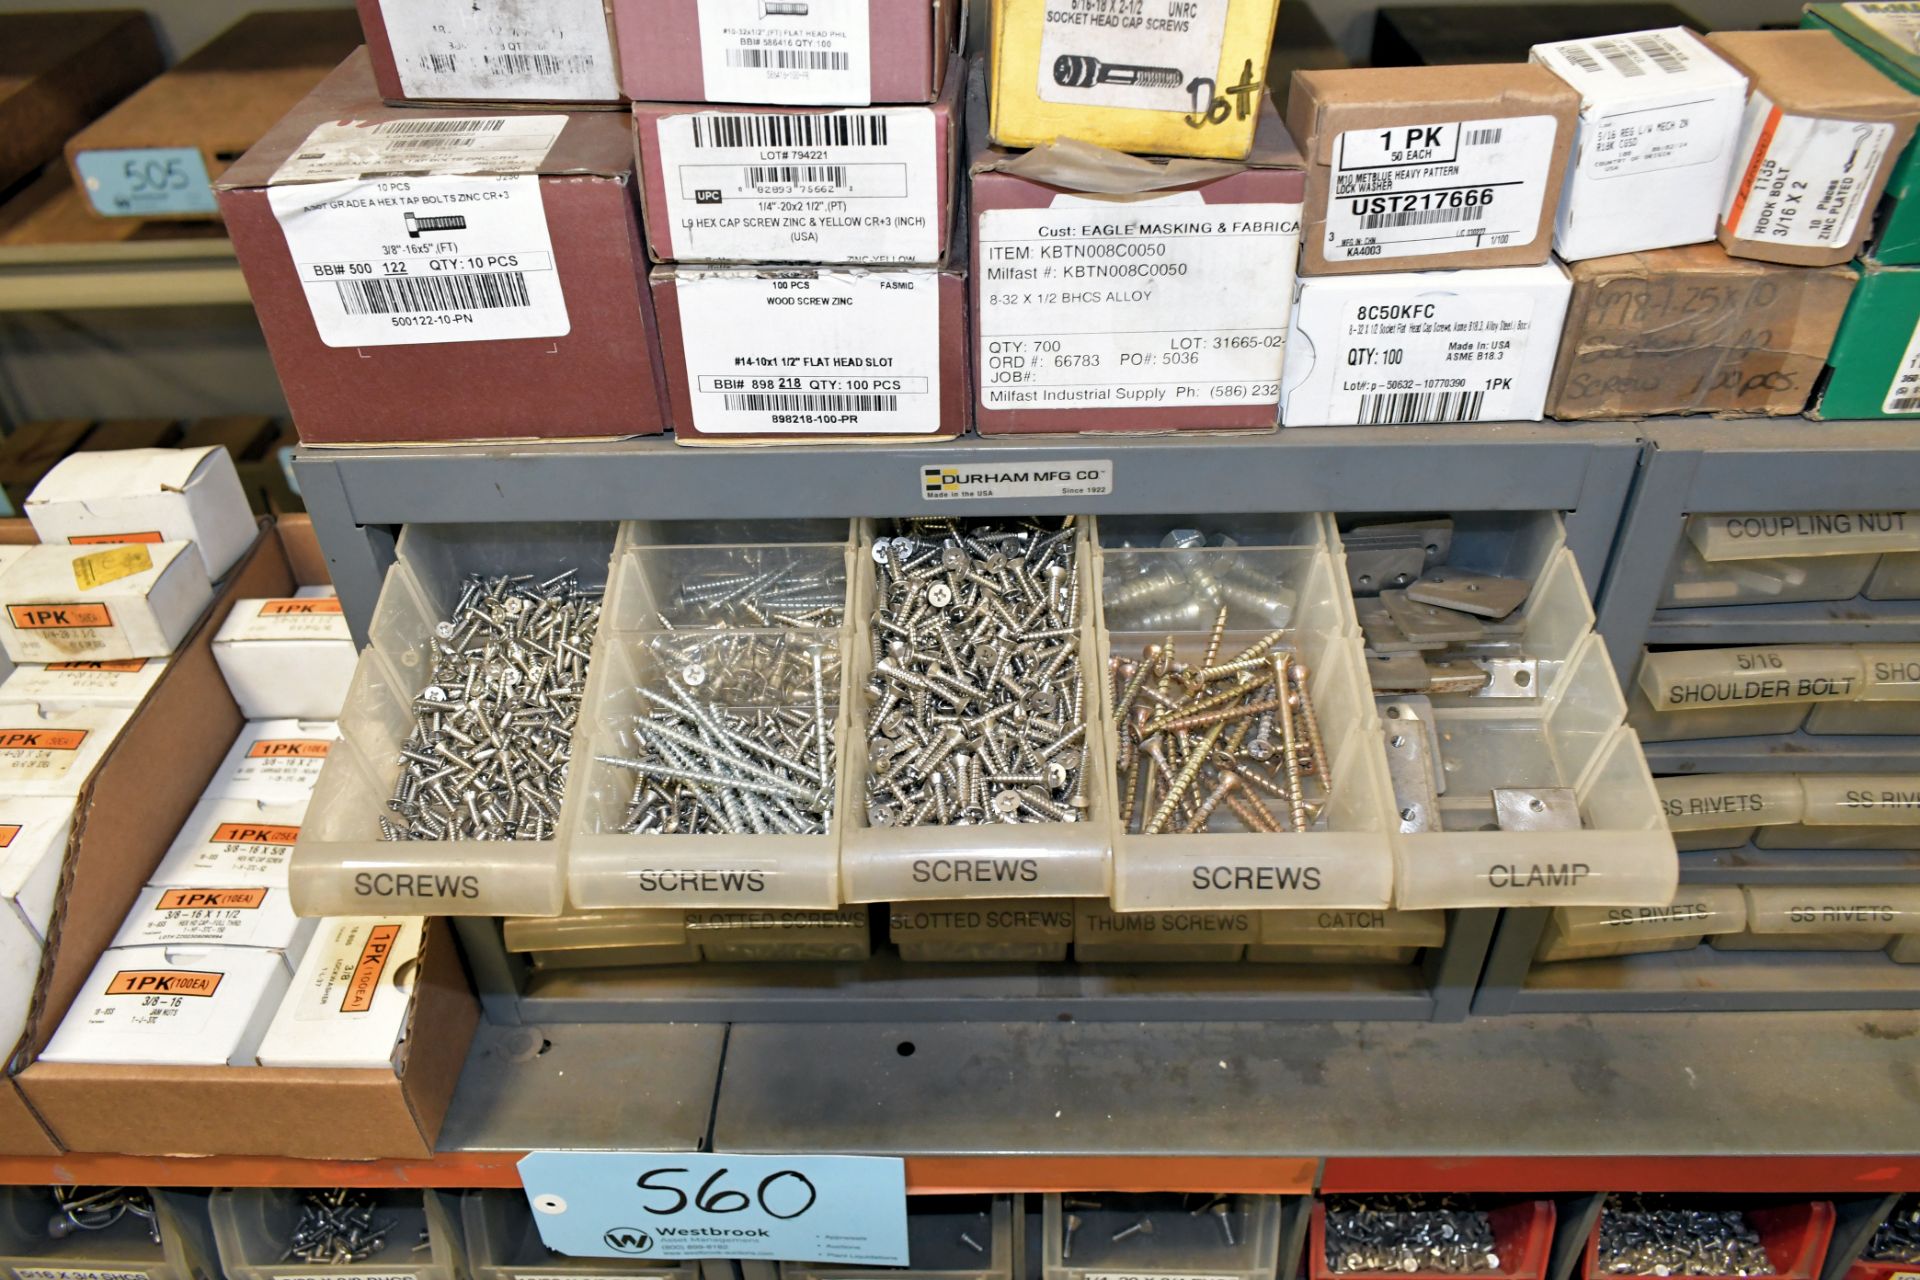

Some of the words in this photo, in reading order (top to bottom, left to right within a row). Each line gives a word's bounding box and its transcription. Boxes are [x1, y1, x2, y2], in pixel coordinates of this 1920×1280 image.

[1168, 2, 1197, 18] UNRC
[1047, 11, 1088, 25] SOCKET
[1090, 14, 1119, 27] HEAD
[1121, 16, 1143, 29] CAP
[1146, 18, 1189, 32] SCREWS
[1406, 127, 1444, 149] PK
[760, 151, 789, 161] LOT#
[791, 151, 828, 161] 794221
[1407, 150, 1432, 160] EACH
[1355, 172, 1392, 184] METBLUE
[1395, 170, 1421, 180] HEAVY
[1423, 166, 1459, 178] PATTERN
[377, 183, 388, 193] 10
[390, 182, 411, 192] PCS
[799, 185, 835, 193] 75662
[1336, 184, 1357, 195] LOCK
[1358, 181, 1393, 192] WASHER
[1791, 181, 1808, 190] 2
[330, 197, 367, 210] GRADE
[378, 197, 398, 208] HEX
[399, 196, 420, 206] TAP
[422, 194, 457, 204] BOLTS
[458, 192, 481, 202] ZINC
[697, 191, 721, 202] UPC
[1352, 189, 1494, 216] UST217666
[1754, 201, 1777, 235] HOOK
[1769, 167, 1791, 197] BOLT
[1785, 194, 1802, 204] X
[1809, 219, 1822, 230] 10
[1816, 179, 1840, 211] Pieces
[1818, 217, 1837, 240] ZINC
[1829, 177, 1855, 215] PLATED
[681, 218, 694, 229] L9
[696, 219, 717, 228] HEX
[719, 218, 741, 228] CAP
[743, 218, 781, 228] SCREW
[782, 218, 807, 227] ZINC
[809, 218, 818, 227] &
[819, 217, 863, 227] YELLOW
[864, 217, 892, 227] CR+3
[893, 216, 926, 228] (INCH)
[1038, 226, 1077, 238] Cust:
[1081, 224, 1134, 237] EAGLE
[1139, 222, 1213, 235] MASKING
[1217, 222, 1227, 234] &
[1232, 221, 1301, 234] FABRICA
[1772, 208, 1797, 237] 3/16
[790, 231, 819, 243] (USA)
[1328, 232, 1335, 242] 3
[989, 246, 1035, 261] ITEM:
[1040, 243, 1166, 259] KBTN008C0050
[1347, 246, 1382, 257] KA4003
[313, 264, 345, 276] BBI#
[349, 263, 373, 275] 500
[383, 261, 408, 276] 122
[429, 259, 465, 272] QTY:
[468, 257, 484, 269] 10
[488, 255, 519, 268] PCS
[987, 267, 1039, 281] Milfast
[1043, 266, 1057, 279] #:
[1063, 263, 1188, 279] KBTN008C0050
[773, 281, 789, 290] 100
[790, 281, 810, 291] PCS
[767, 296, 796, 306] WOOD
[797, 296, 830, 306] SCREW
[832, 296, 853, 306] ZINC
[990, 293, 1019, 306] 8-32
[1023, 293, 1033, 304] X
[1038, 292, 1057, 304] 1/2
[1061, 291, 1102, 304] BHCS
[1106, 291, 1152, 303] ALLOY
[391, 313, 474, 327] 500122-10-PN
[1356, 304, 1436, 321] 8C50KFC
[989, 341, 1027, 354] QTY:
[1033, 340, 1061, 353] 700
[1170, 336, 1207, 351] LOT:
[1383, 348, 1403, 365] 100
[1448, 341, 1474, 351] Made
[1491, 340, 1511, 350] USA
[735, 357, 778, 368] #14-10x1
[781, 357, 801, 367] 1/2"
[803, 357, 830, 367] FLAT
[833, 357, 863, 367] HEAD
[865, 357, 893, 367] SLOT
[989, 355, 1025, 370] ORD
[1030, 355, 1044, 368] #:
[1054, 354, 1100, 368] 66783
[1120, 352, 1157, 367] PO#:
[1162, 352, 1199, 365] 5036
[1446, 352, 1474, 362] ASME
[1476, 351, 1504, 361] B18.3
[714, 378, 745, 390] BBI#
[751, 378, 775, 390] 898
[778, 377, 802, 390] 218
[809, 379, 842, 391] QTY:
[846, 379, 869, 390] 100
[873, 379, 902, 390] PCS
[1485, 378, 1513, 391] 1PK
[990, 388, 1038, 403] Milfast
[1042, 387, 1111, 401] Industrial
[1115, 386, 1167, 403] Supply
[1210, 384, 1248, 399] (586)
[771, 414, 858, 424] 898218-100-PR
[942, 472, 1029, 485] DURHAM
[1033, 471, 1071, 482] MFG
[1087, 486, 1106, 494] 1922
[1726, 515, 1852, 539] COUPLING
[1857, 511, 1908, 533] NUT
[23, 610, 70, 625] 1PK
[274, 604, 315, 614] 1PK
[1736, 653, 1783, 670] 5/16
[1669, 679, 1791, 704] SHOULDER
[1796, 676, 1856, 697] BOLT
[261, 743, 304, 754] 1PK
[1690, 793, 1764, 815] RIVETS
[1846, 791, 1874, 809] SS
[230, 828, 272, 842] 1PK
[912, 859, 1038, 883] SCREWS
[1193, 866, 1321, 891] SCREWS
[1488, 863, 1590, 889] CLAMP
[354, 872, 480, 899] SCREWS
[639, 868, 765, 892] SCREWS
[176, 894, 222, 906] 1PK
[685, 912, 774, 931] SLOTTED
[781, 912, 866, 929] SCREWS
[891, 912, 981, 930] SLOTTED
[986, 911, 1073, 929] SCREWS
[1087, 914, 1156, 933] THUMB
[1161, 913, 1249, 932] SCREWS
[1317, 911, 1385, 929] CATCH
[1608, 908, 1634, 927] SS
[1640, 903, 1710, 924] RIVETS
[1790, 906, 1816, 924] SS
[1822, 905, 1895, 923] RIVETS
[362, 933, 391, 966] 1PK
[126, 976, 173, 991] 1PK
[170, 977, 210, 990] (100EA)
[351, 965, 373, 1008] (100EA)
[142, 996, 160, 1007] 3/8
[170, 997, 183, 1008] 16
[636, 1167, 817, 1220] 560
[655, 1226, 771, 1238] Westbrook
